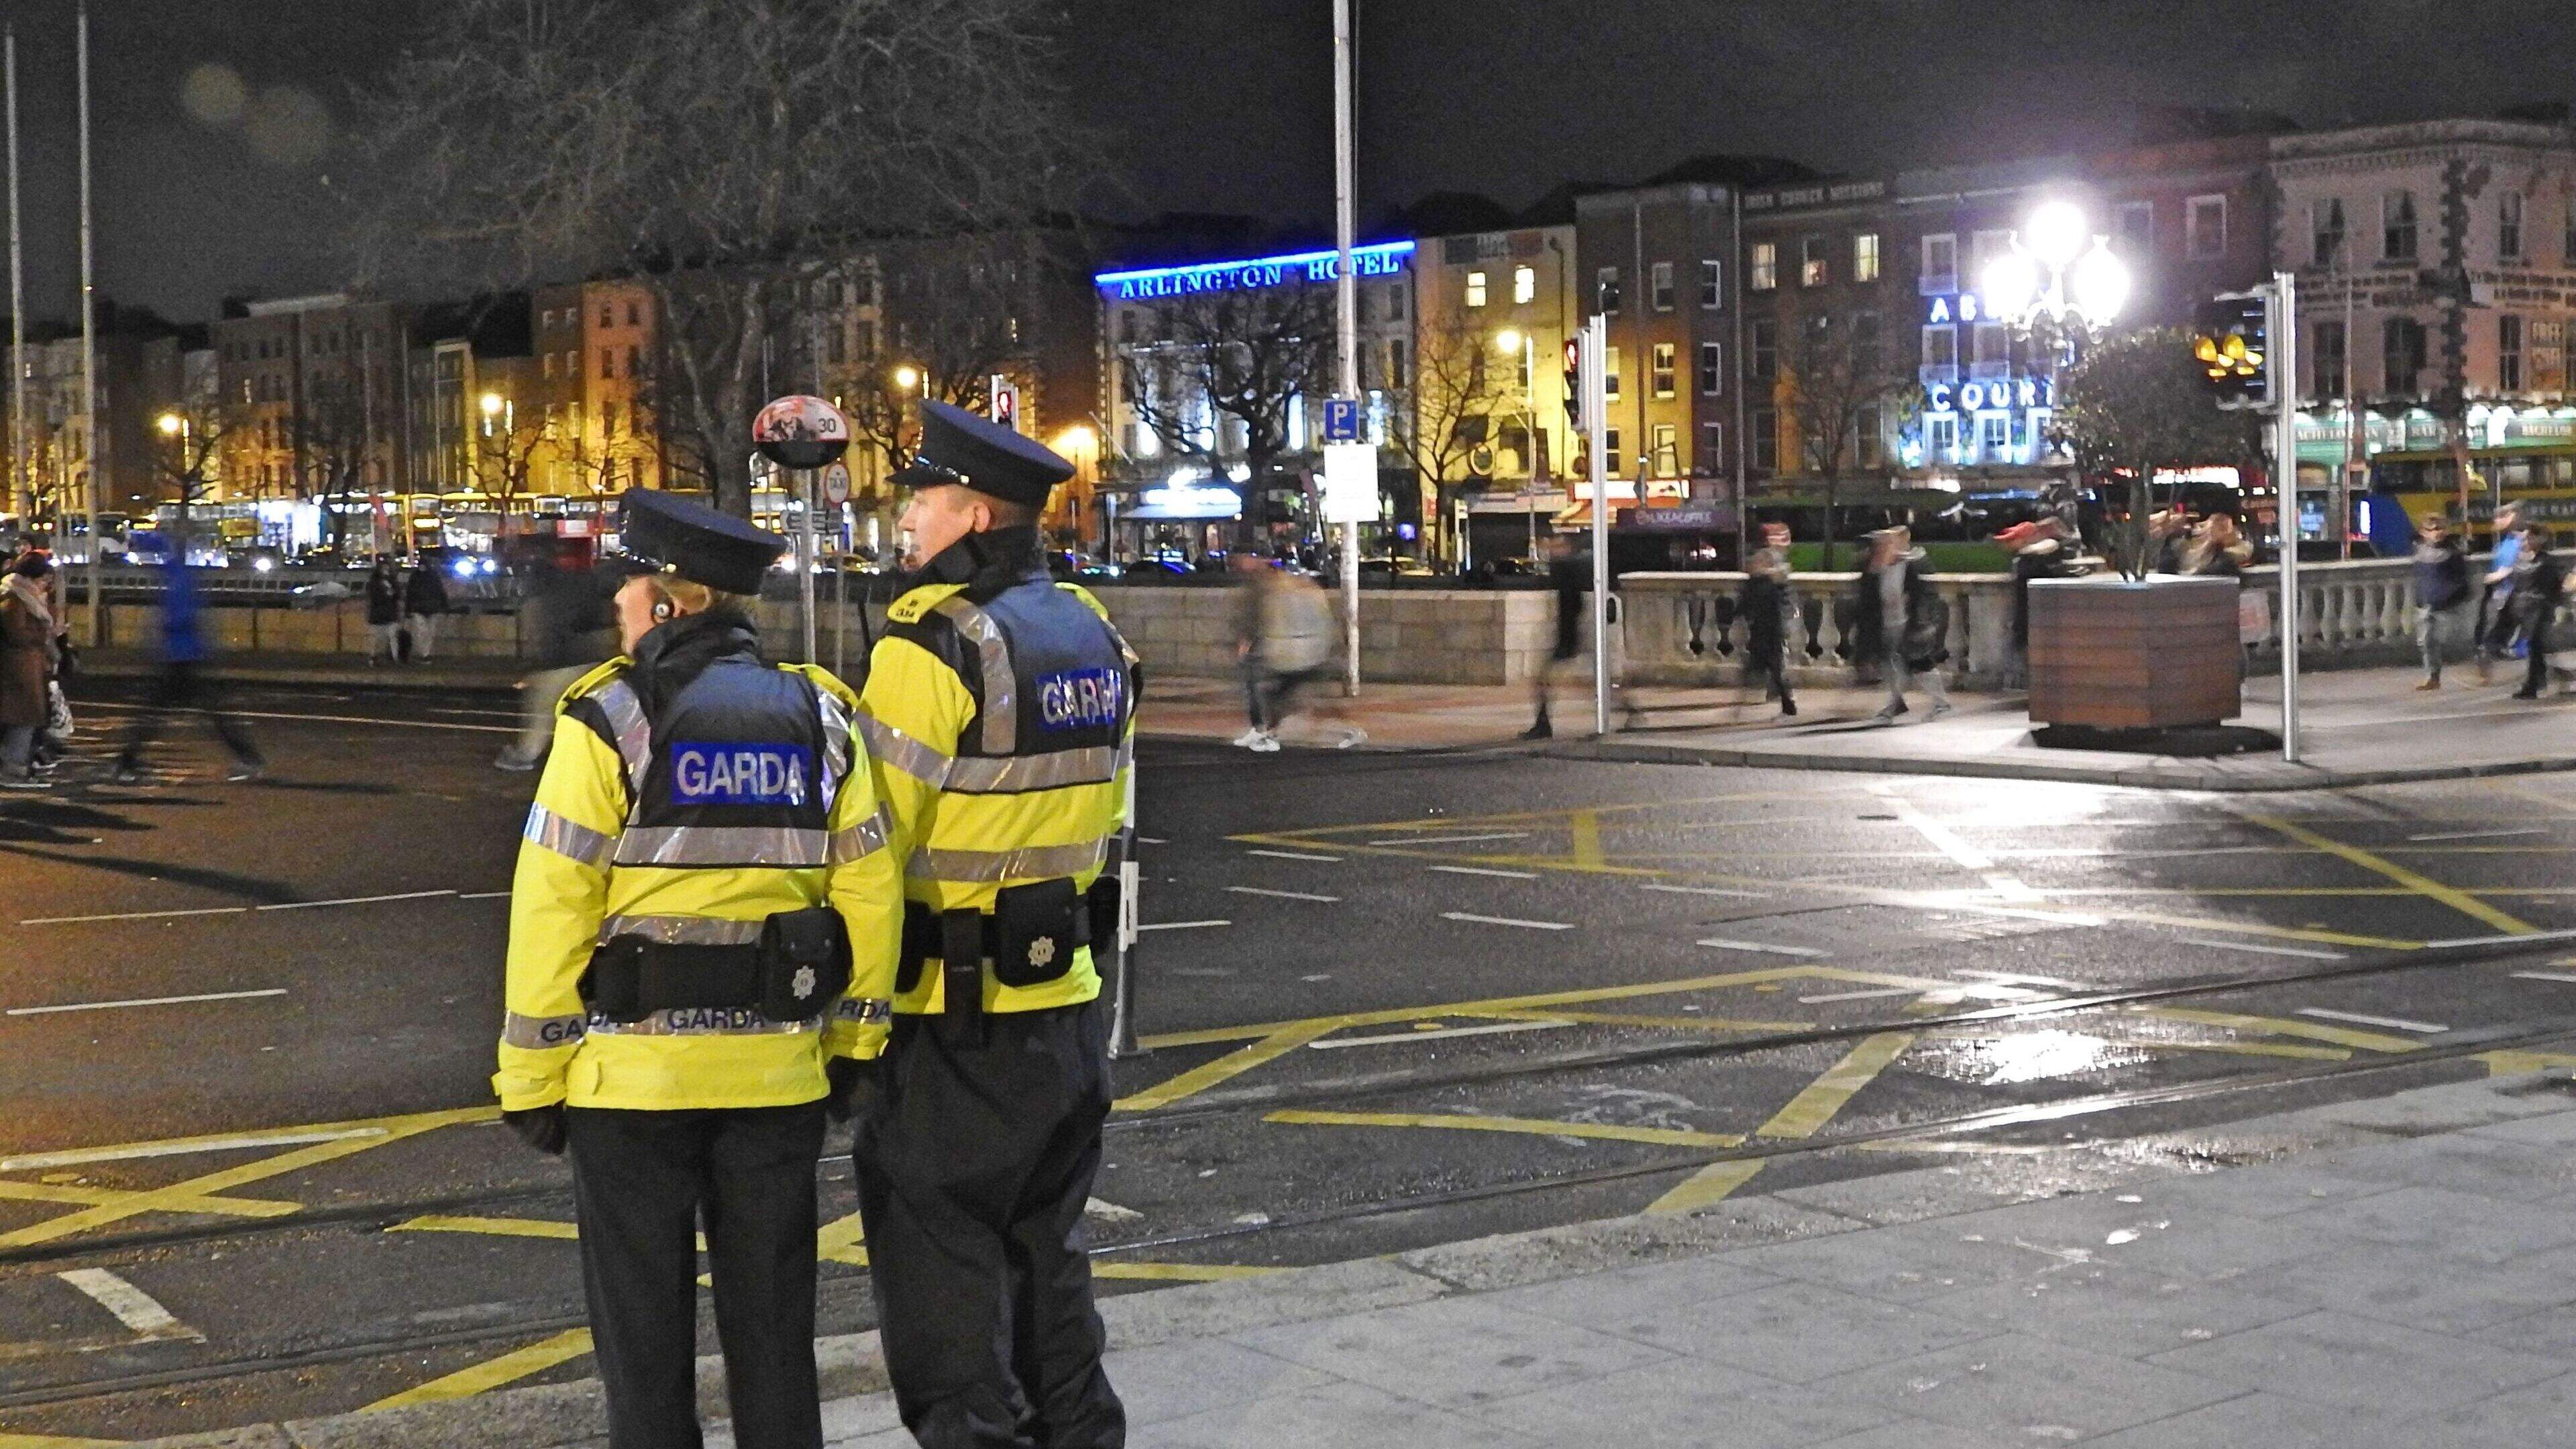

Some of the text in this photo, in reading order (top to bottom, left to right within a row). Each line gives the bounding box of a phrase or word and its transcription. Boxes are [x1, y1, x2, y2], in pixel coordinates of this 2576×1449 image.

[1120, 264, 1282, 299] ARLINGTON
[818, 417, 837, 433] 30
[1333, 404, 1348, 426] P
[677, 750, 805, 797] GARDA
[667, 1005, 766, 1030] GARDA
[839, 998, 890, 1020] RDA
